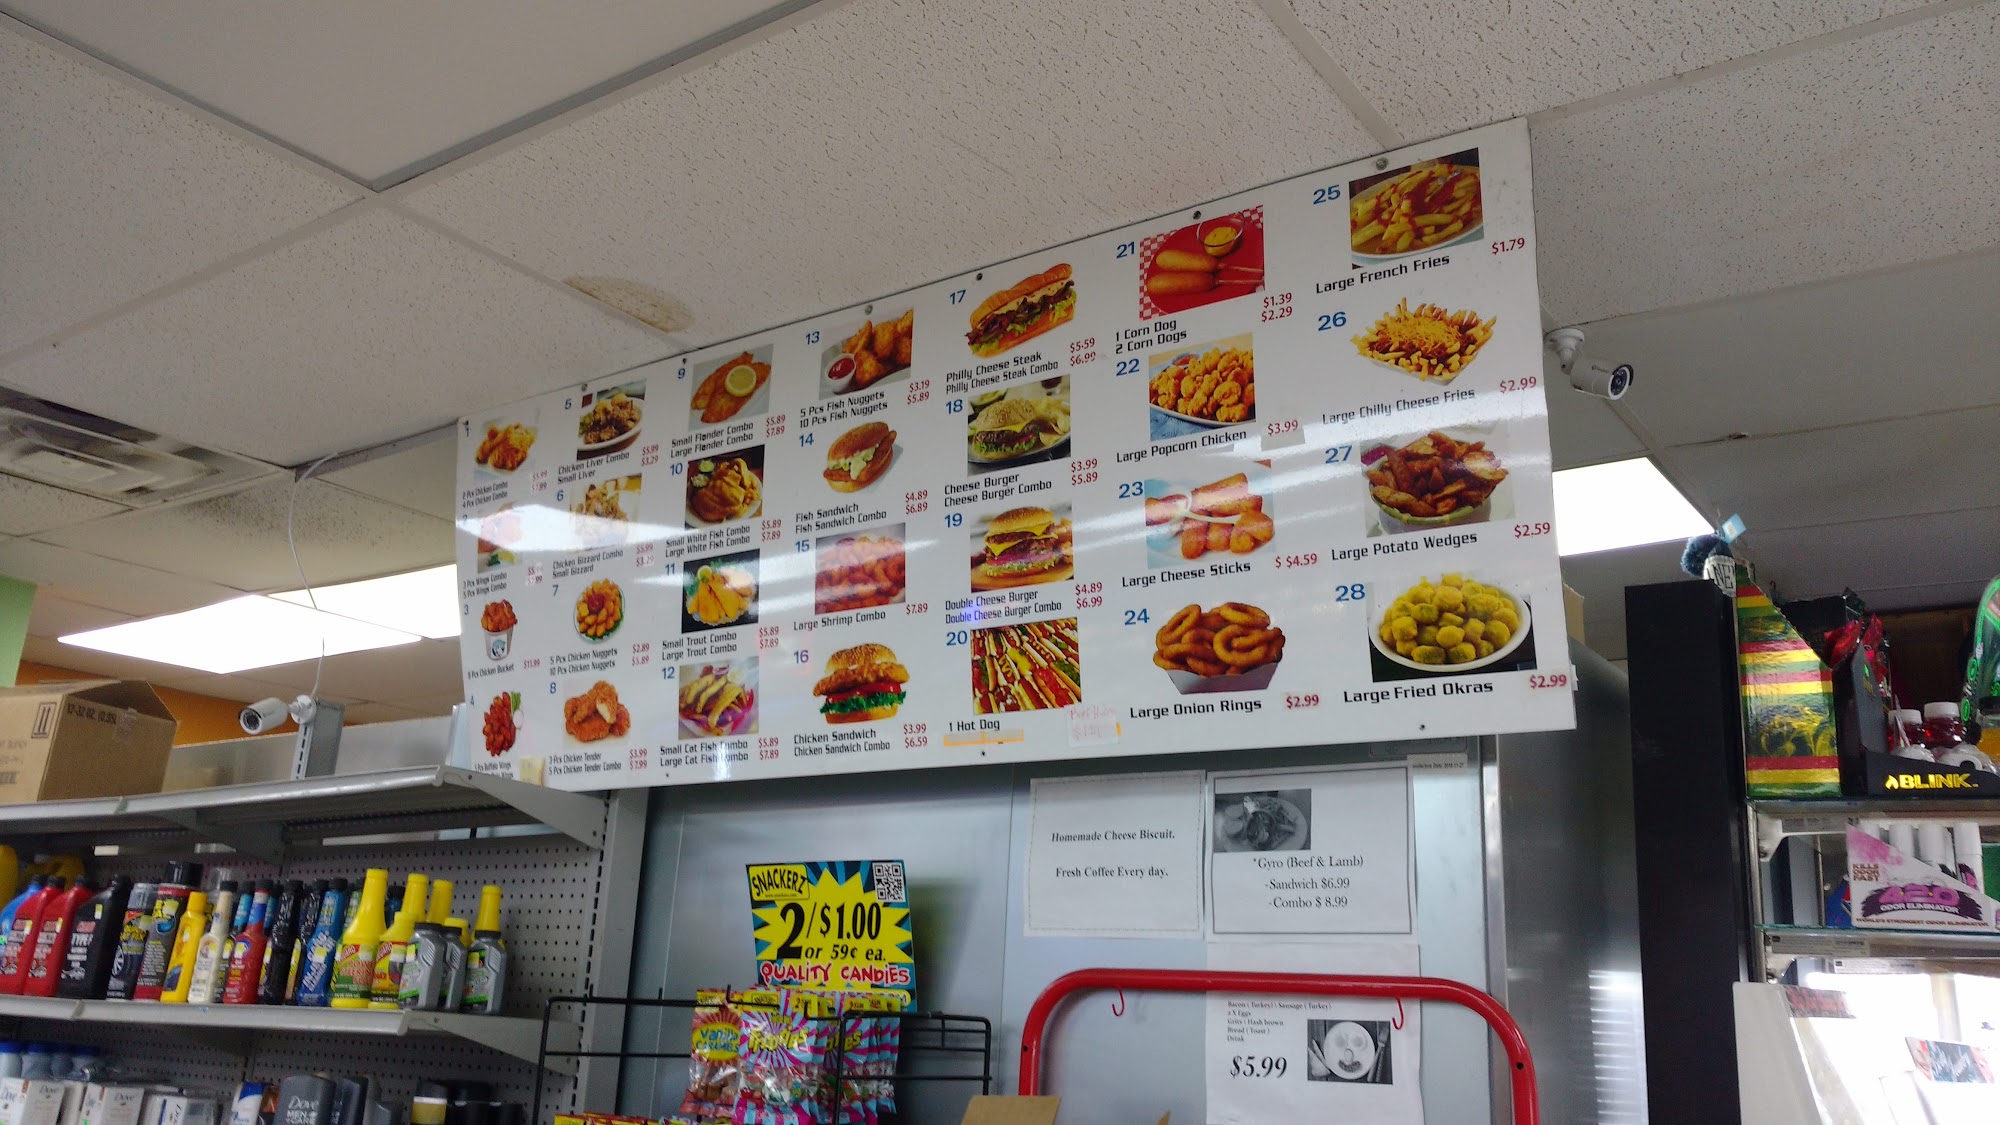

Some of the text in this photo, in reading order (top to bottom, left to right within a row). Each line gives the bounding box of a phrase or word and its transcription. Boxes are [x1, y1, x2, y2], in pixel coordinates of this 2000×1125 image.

[1313, 185, 1340, 205] 25
[1116, 241, 1135, 259] 21
[1491, 237, 1525, 255] $1.79
[1316, 255, 1450, 294] Large French Fries
[950, 290, 966, 305] 17
[1263, 293, 1292, 308] $1.39
[1261, 306, 1293, 322] $2.29
[1318, 311, 1347, 331] 26
[805, 331, 820, 345] 13
[1116, 320, 1177, 342] 1 Corn Dog
[1070, 338, 1095, 354] $5.59
[1115, 330, 1187, 354] 2 Corn Dogs
[946, 352, 1042, 383] Philly Cheese Steak
[1116, 358, 1140, 376] 22
[946, 360, 1058, 394] Philly Cheese Steak Combo
[1500, 376, 1537, 394] $2.99
[909, 380, 930, 393] $3.19
[800, 391, 885, 418] 5 Pcs Fish Nuggets
[945, 399, 963, 414] 18
[1322, 389, 1475, 424] Large Chilly Cheese Fries
[1267, 420, 1299, 436] $3.99
[799, 433, 814, 447] 14
[1117, 431, 1246, 463] Large Popcorn Chicken
[1325, 445, 1353, 464] 27
[1071, 459, 1098, 473] $3.99
[945, 474, 1019, 495] Cheese Burger
[1071, 472, 1098, 486] $5.89
[905, 490, 928, 503] $4.89
[945, 480, 1052, 507] Cheese Burger Combo
[1119, 482, 1143, 499] 23
[795, 502, 859, 523] Fish Sandwich
[905, 502, 928, 515] $6.89
[795, 510, 887, 535] Fish Sandwich Combo
[944, 513, 962, 528] 19
[1514, 523, 1551, 538] $2.59
[1332, 532, 1477, 561] Large Potato Wedges
[1286, 553, 1317, 569] $4.59
[1122, 562, 1251, 588] Large Cheese Sticks
[1075, 582, 1102, 596] $4.89
[1336, 583, 1366, 601] 28
[906, 603, 928, 615] $7.89
[945, 591, 1038, 610] Double Cheese Burger
[1076, 596, 1102, 610] $6.99
[794, 611, 886, 631] Large Shrimp Combo
[945, 601, 1062, 624] Double Cheese Burger Combo
[1124, 608, 1150, 626] 24
[662, 632, 737, 649] Small Trout Combo
[759, 627, 779, 637] $5.89
[946, 631, 968, 646] 20
[568, 651, 590, 661] Chicken
[593, 648, 618, 660] Nuggets
[633, 643, 650, 653] $2.89
[794, 650, 809, 664] 16
[1529, 674, 1567, 688] $2.99
[1344, 681, 1493, 703] Large Fried Okras
[1130, 700, 1262, 720] Large Onion Rings
[1286, 695, 1319, 710] $2.99
[904, 724, 926, 735] $3.99
[949, 719, 1000, 732] 1 Hot Dog
[794, 728, 876, 745] Chicken Sandwich
[905, 736, 928, 749] $6.59
[794, 740, 890, 757] Chicken Sandwich Combo
[1052, 829, 1175, 842] Homemade Cheese Biscuit.
[1287, 856, 1314, 869] (Beef
[1317, 857, 1324, 867] &
[1329, 855, 1363, 867] Lamb)
[1056, 866, 1168, 879] Fresh Coffee Every day.
[752, 868, 807, 896] SNACKERZ
[1321, 878, 1350, 889] $6.99
[1880, 903, 1960, 914] ODOR ELIMINATOR
[805, 944, 886, 961] or 59¢ ea.
[1230, 1055, 1287, 1078] $5.99
